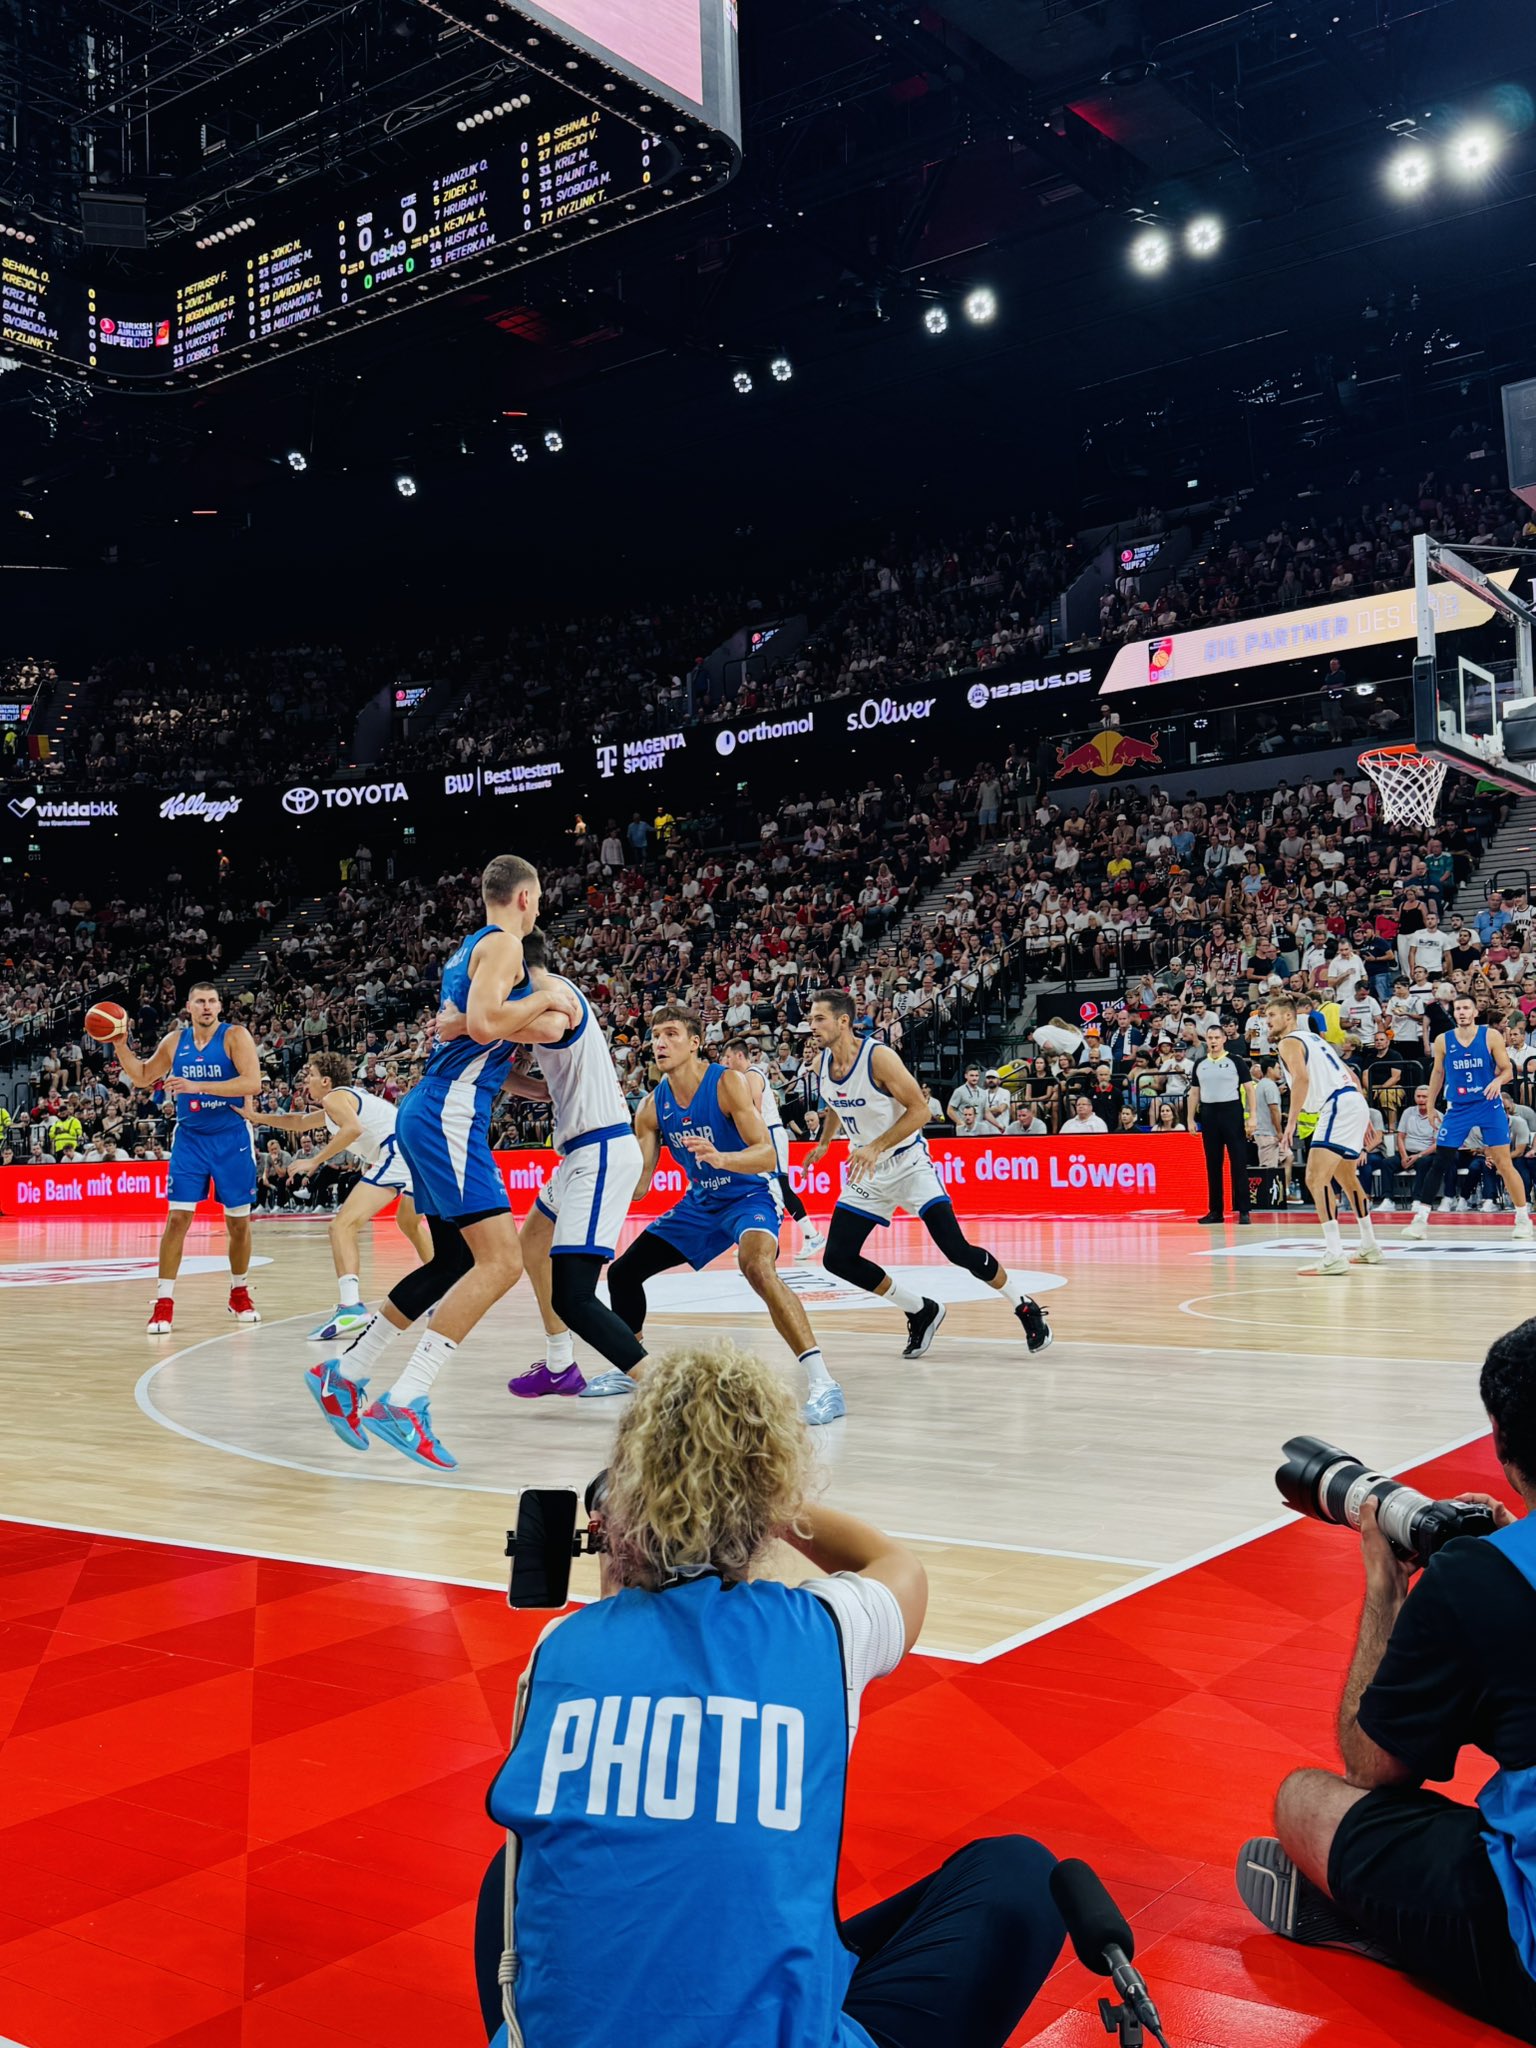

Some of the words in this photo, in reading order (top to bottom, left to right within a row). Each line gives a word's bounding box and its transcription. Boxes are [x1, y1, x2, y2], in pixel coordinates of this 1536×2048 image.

[537, 132, 551, 146] 19
[553, 116, 590, 139] SEHNAL
[538, 148, 551, 162] 27
[554, 133, 588, 155] KREJCI
[589, 128, 598, 140] V.
[433, 180, 440, 191] 2
[442, 163, 478, 188] HANZLIK
[520, 142, 528, 153] 0
[538, 164, 551, 177] 31
[554, 153, 578, 171] KRIZ
[578, 148, 590, 160] M.
[641, 139, 649, 150] 0
[433, 195, 440, 206] 5
[443, 185, 468, 203] ZIDEK
[469, 179, 478, 190] J.
[521, 157, 528, 168] 0
[539, 180, 552, 192] 32
[555, 164, 587, 187] BALINT
[589, 160, 598, 173] R.
[642, 155, 650, 167] 0
[400, 193, 417, 208] CZE
[434, 210, 440, 221] 7
[443, 196, 479, 217] HRUBAN
[479, 190, 488, 201] V.
[522, 172, 529, 184] 0
[539, 195, 553, 209] 71
[556, 177, 599, 203] SVOBODA
[600, 171, 611, 184] M.
[642, 171, 650, 183] 0
[428, 225, 441, 238] 11
[443, 212, 477, 233] KEJVAL
[522, 188, 530, 200] 0
[540, 210, 554, 224] 77
[556, 194, 598, 218] KYZLINK
[598, 189, 607, 202] T.
[258, 253, 269, 266] 15
[270, 243, 293, 260] JOKIC
[338, 220, 345, 231] 0
[358, 227, 372, 252] 0
[384, 227, 394, 239] 1.
[402, 208, 417, 234] 0
[429, 241, 442, 253] 14
[444, 227, 478, 248] HUSTAK
[523, 204, 530, 215] 0
[258, 267, 269, 279] 23
[271, 253, 302, 274] GUDURIC
[303, 249, 313, 261] M.
[339, 235, 346, 245] 0
[370, 240, 407, 267] 09:49
[430, 255, 443, 268] 15
[445, 240, 486, 263] PETERKA
[486, 234, 496, 246] M.
[524, 219, 531, 231] 0
[2, 258, 40, 279] SEHNAL
[271, 271, 294, 288] JOVIC
[293, 268, 301, 279] S.
[340, 249, 346, 260] 0
[375, 264, 404, 284] FOULS
[405, 257, 414, 273] 0
[2, 272, 37, 293] KREJCI
[38, 284, 47, 295] V.
[2, 285, 25, 301] KRIZ
[28, 294, 38, 306] M.
[177, 290, 183, 299] 3
[184, 273, 220, 297] PETRUSEV
[221, 270, 229, 282] F.
[259, 295, 270, 307] 27
[272, 277, 313, 302] DAVIDOVAC
[340, 264, 347, 274] 0
[364, 274, 373, 289] 0
[2, 299, 35, 318] BALINT
[38, 311, 46, 322] R.
[177, 303, 183, 313] 5
[185, 294, 206, 310] JOVIC
[177, 316, 183, 326] 7
[185, 298, 228, 323] BOGDANOVIC
[260, 309, 271, 321] 30
[273, 291, 315, 317] AVRAMOVIC
[341, 278, 347, 289] 0
[260, 322, 272, 335] 33
[273, 310, 311, 331] MILUTINOV
[341, 292, 348, 303] 0
[3, 314, 47, 336] SVOBODA
[49, 329, 59, 340] M.
[117, 321, 153, 329] TURKISH
[117, 329, 153, 337] AIRLINES
[177, 329, 183, 339] 9
[227, 310, 235, 320] V.
[3, 328, 43, 349] KYZLINK
[46, 341, 54, 352] T.
[100, 332, 153, 348] SUPERCUP
[173, 344, 183, 355] 11
[185, 329, 220, 350] VUKCEVIC
[220, 327, 227, 337] T.
[173, 356, 184, 368] 13
[186, 346, 212, 364] DOBRIC
[1245, 616, 1348, 652] PARTNER
[1356, 605, 1401, 635] DES
[989, 668, 1092, 699] 123BUS.DE
[738, 712, 814, 745] orthomol
[847, 697, 936, 731] s.Oliver
[623, 733, 687, 758] MAGENTA
[484, 769, 512, 786] Best
[623, 752, 666, 774] SPORT
[322, 782, 409, 808] TOYOTA
[445, 773, 474, 795] BW
[36, 801, 119, 817] vividabkk
[159, 792, 243, 822] Kellogg's
[1466, 1072, 1473, 1082] 3
[200, 1100, 226, 1110] triglav
[842, 1116, 860, 1135] 77
[510, 1161, 545, 1189] mit
[701, 1176, 731, 1190] triglav
[789, 1165, 830, 1194] Die
[975, 1150, 1039, 1181] dem
[1050, 1154, 1156, 1189] Löwen
[17, 1181, 40, 1204] Die
[45, 1178, 82, 1201] Bank
[87, 1172, 112, 1197] mit
[117, 1171, 150, 1194] dem
[534, 1695, 805, 1831] PHOTO
